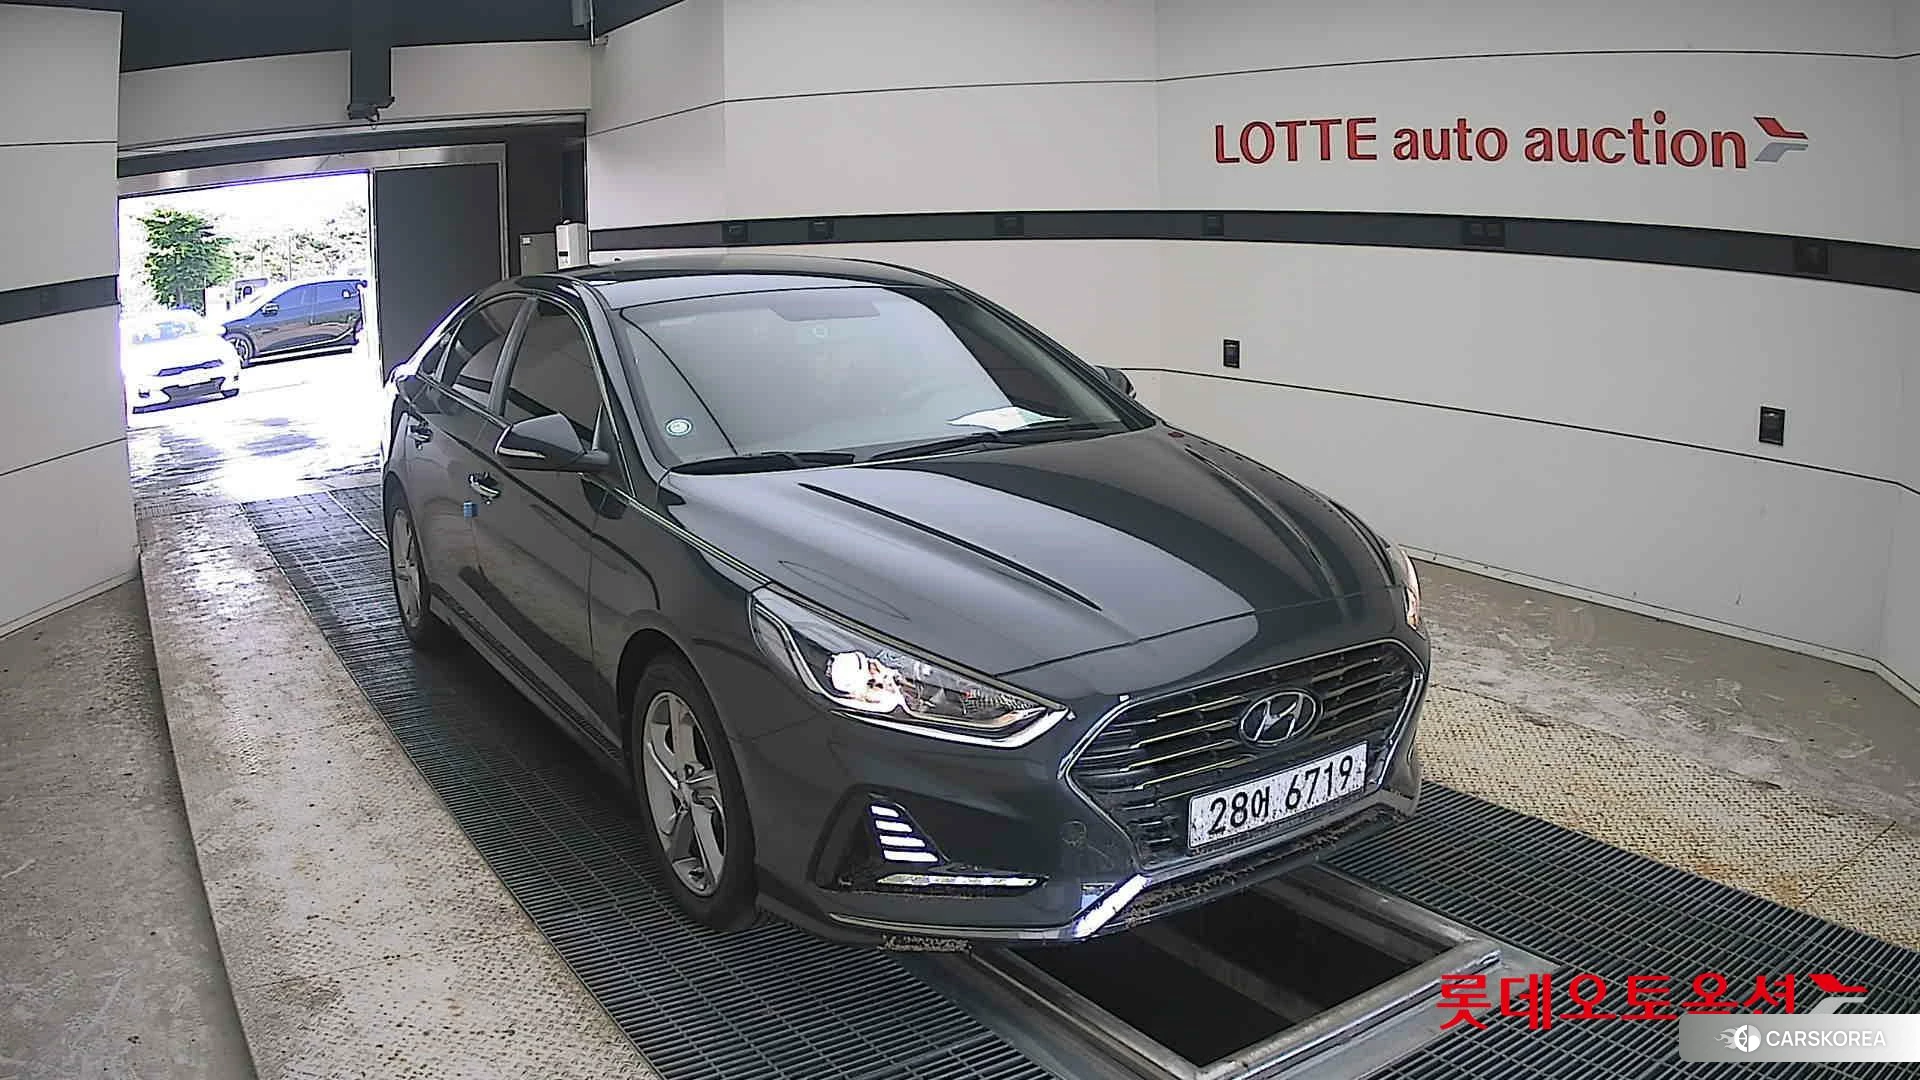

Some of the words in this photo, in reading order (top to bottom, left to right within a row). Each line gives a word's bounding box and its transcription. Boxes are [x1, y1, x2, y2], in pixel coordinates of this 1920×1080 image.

[1215, 117, 1377, 164] LOTTE
[1393, 118, 1508, 161] auto
[1524, 110, 1747, 168] auction
[1207, 786, 1271, 836] 28어
[1285, 755, 1353, 810] 6719
